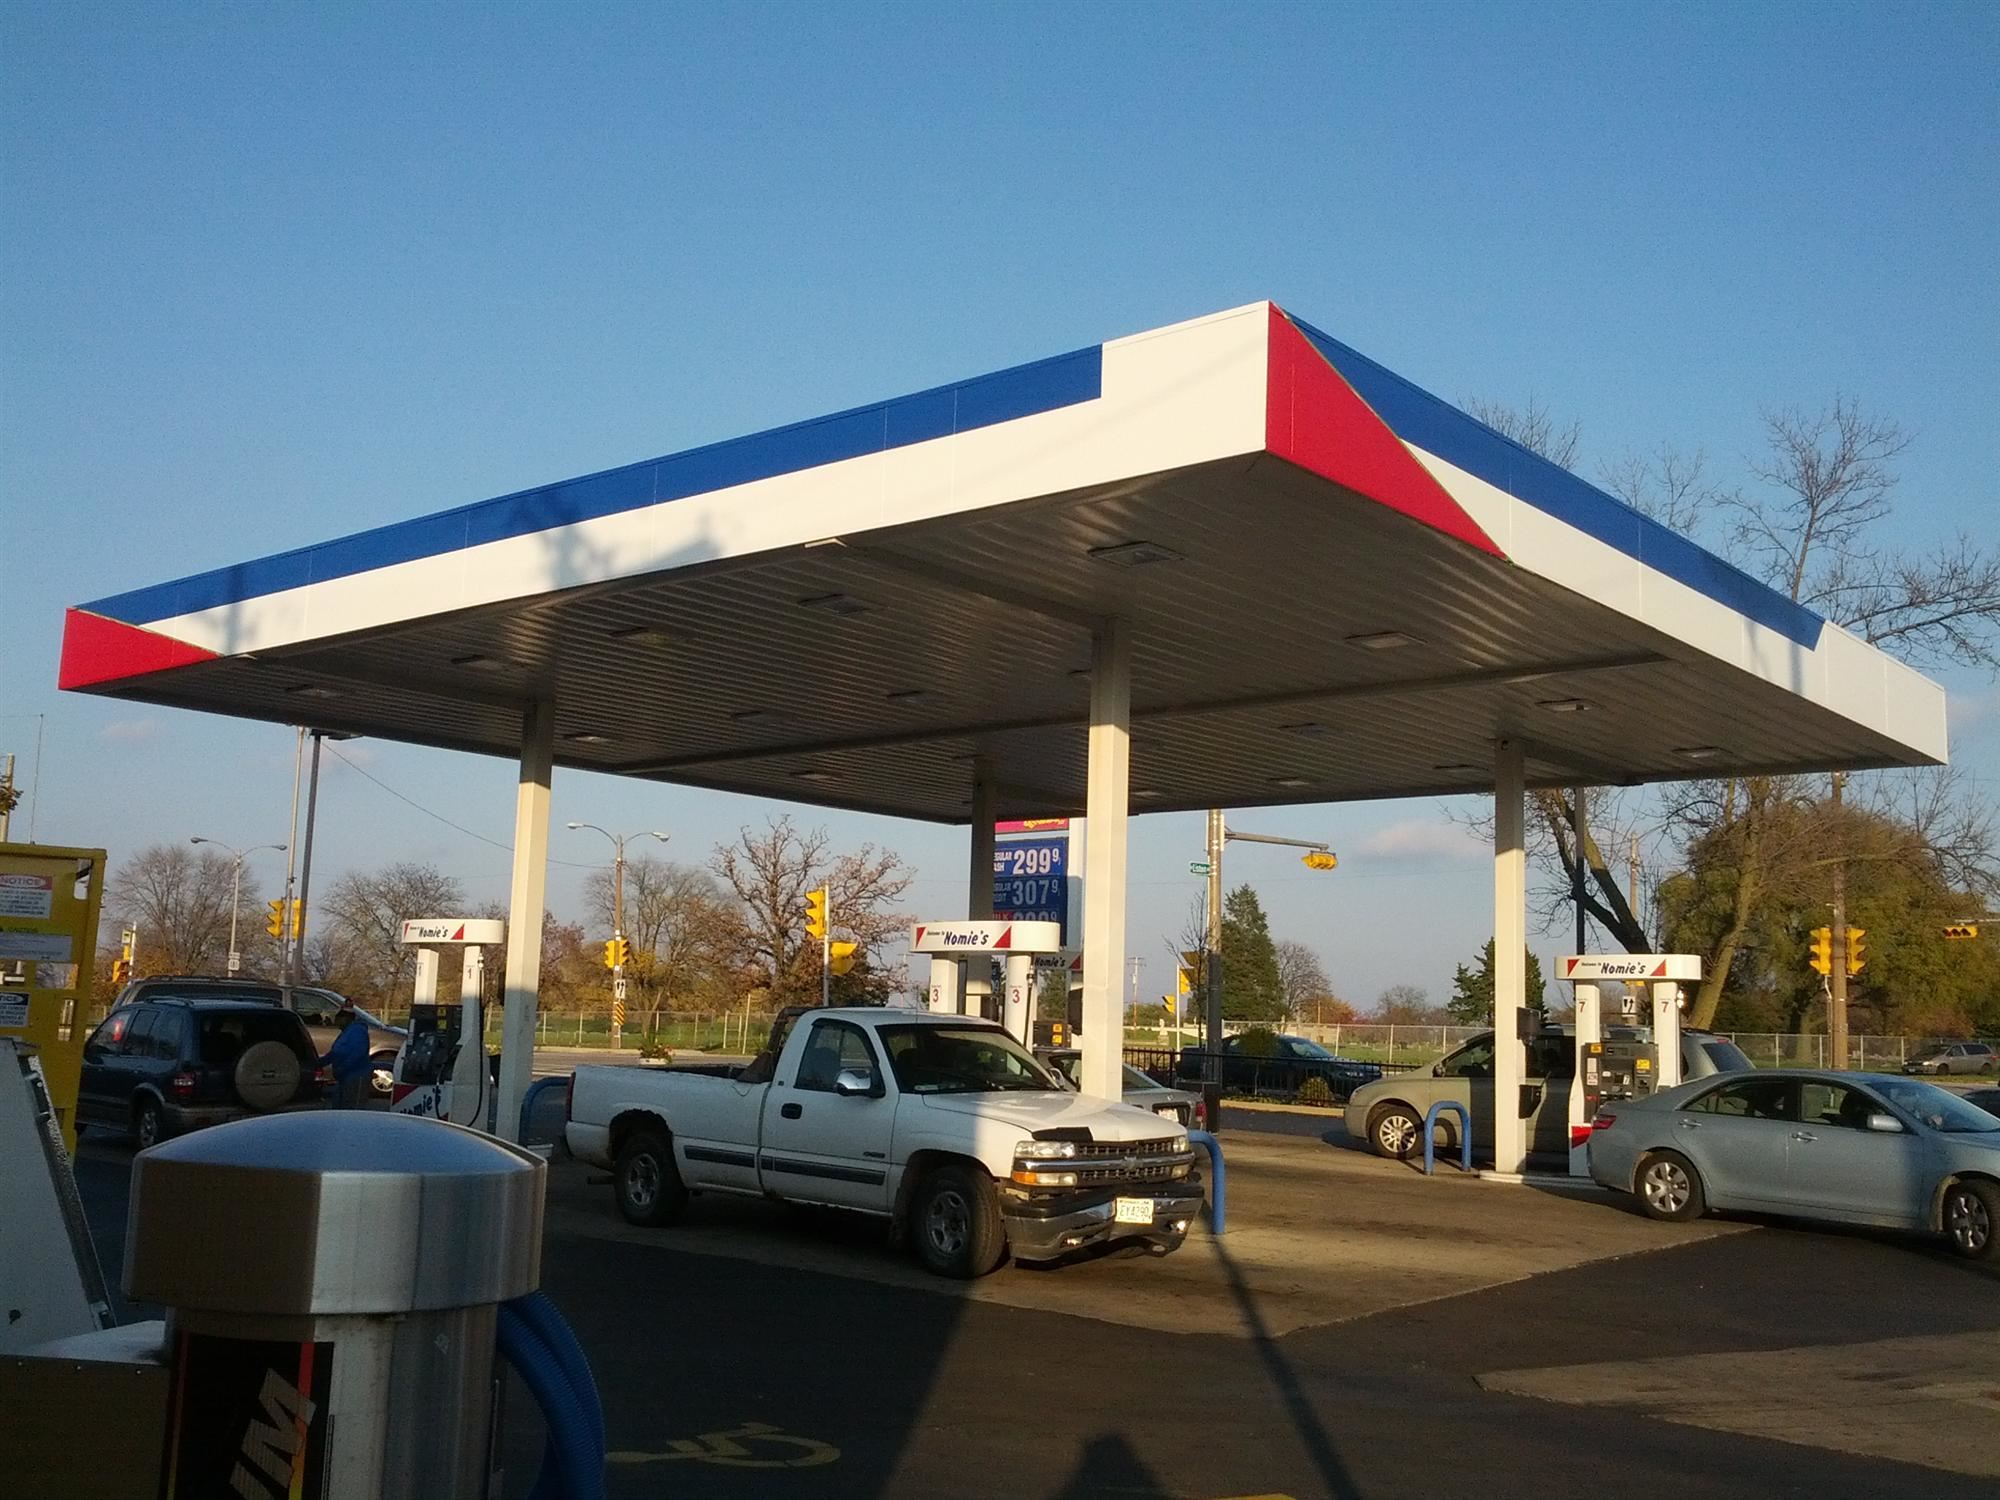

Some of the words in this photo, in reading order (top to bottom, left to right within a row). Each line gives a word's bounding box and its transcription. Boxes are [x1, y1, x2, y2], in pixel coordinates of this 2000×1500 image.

[1013, 848, 1051, 874] 299
[1052, 848, 1059, 862] 9
[1012, 879, 1049, 905] 307
[1051, 879, 1058, 893] 9
[419, 926, 448, 938] Nomie's
[943, 930, 989, 946] Nomie's
[467, 968, 473, 979] 1
[1600, 962, 1646, 974] Nomie's
[932, 989, 939, 1003] 3
[1012, 989, 1020, 1003] 3
[1579, 1002, 1585, 1013] 7
[1661, 1002, 1669, 1013] 7
